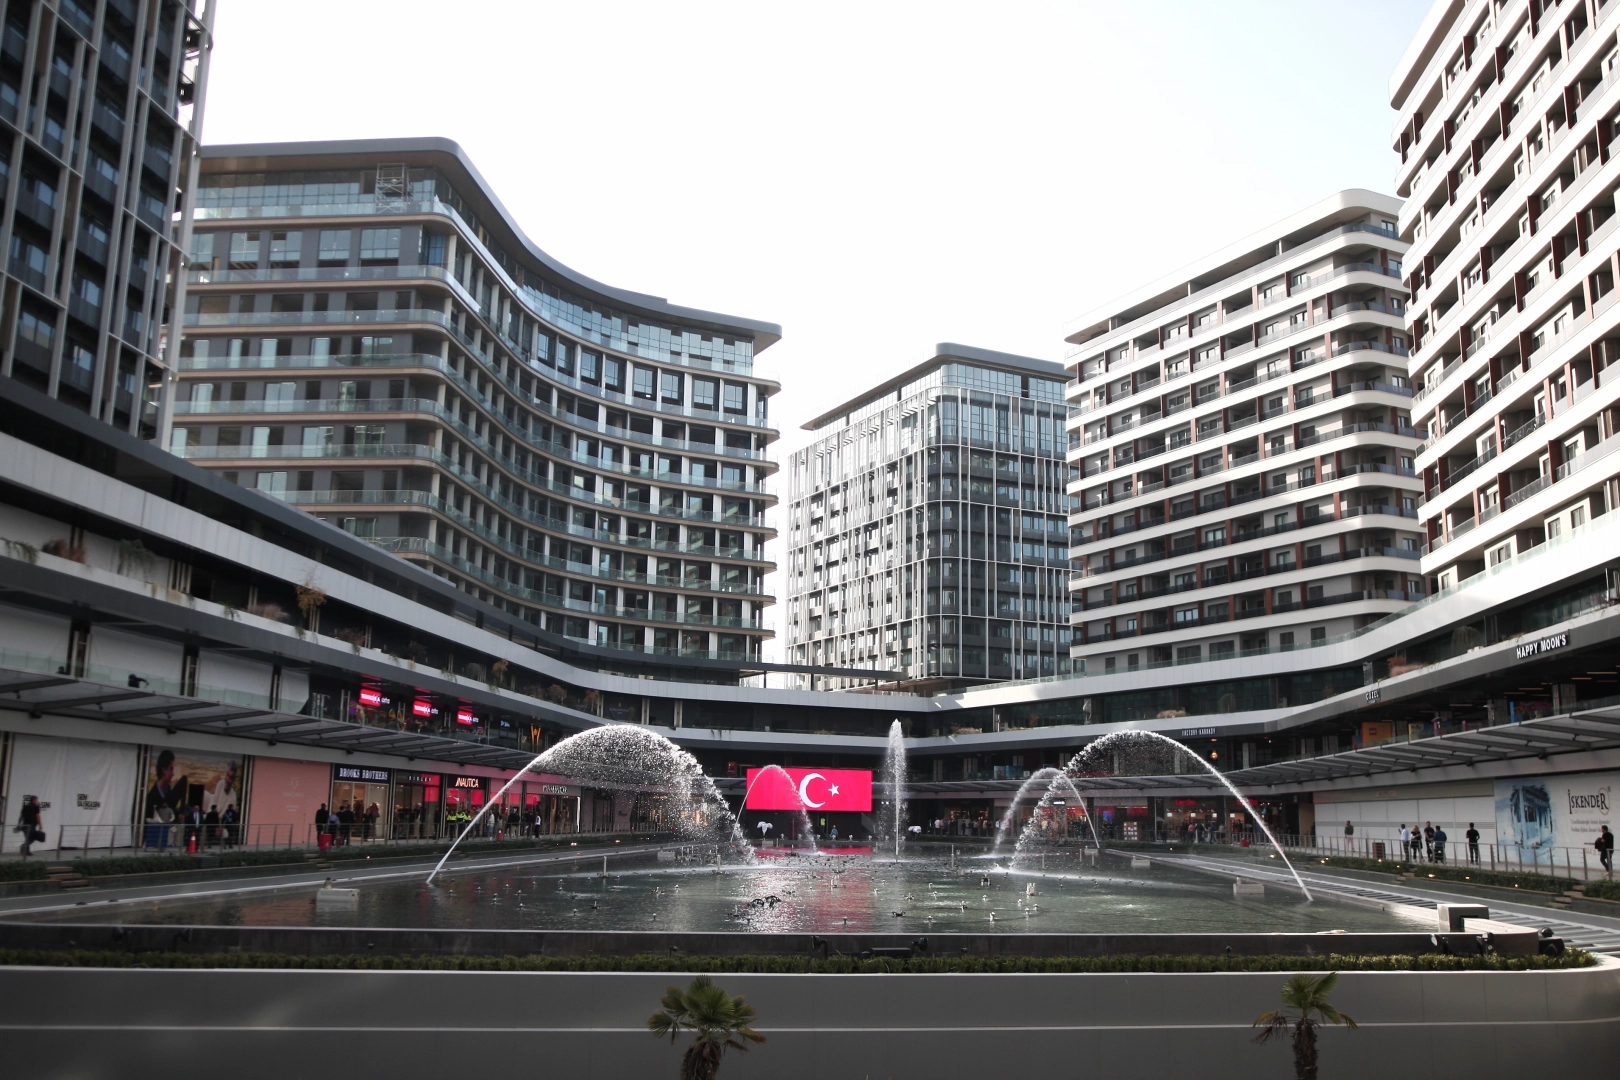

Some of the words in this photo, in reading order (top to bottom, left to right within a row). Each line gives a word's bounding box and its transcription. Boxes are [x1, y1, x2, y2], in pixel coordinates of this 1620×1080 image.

[1516, 642, 1538, 660] HAPPY
[1540, 634, 1566, 652] MOON'S
[1181, 729, 1198, 737] FACTORY
[339, 767, 360, 778] BROOKS
[361, 769, 388, 781] BROTHERS
[455, 777, 479, 788] NAUTICA
